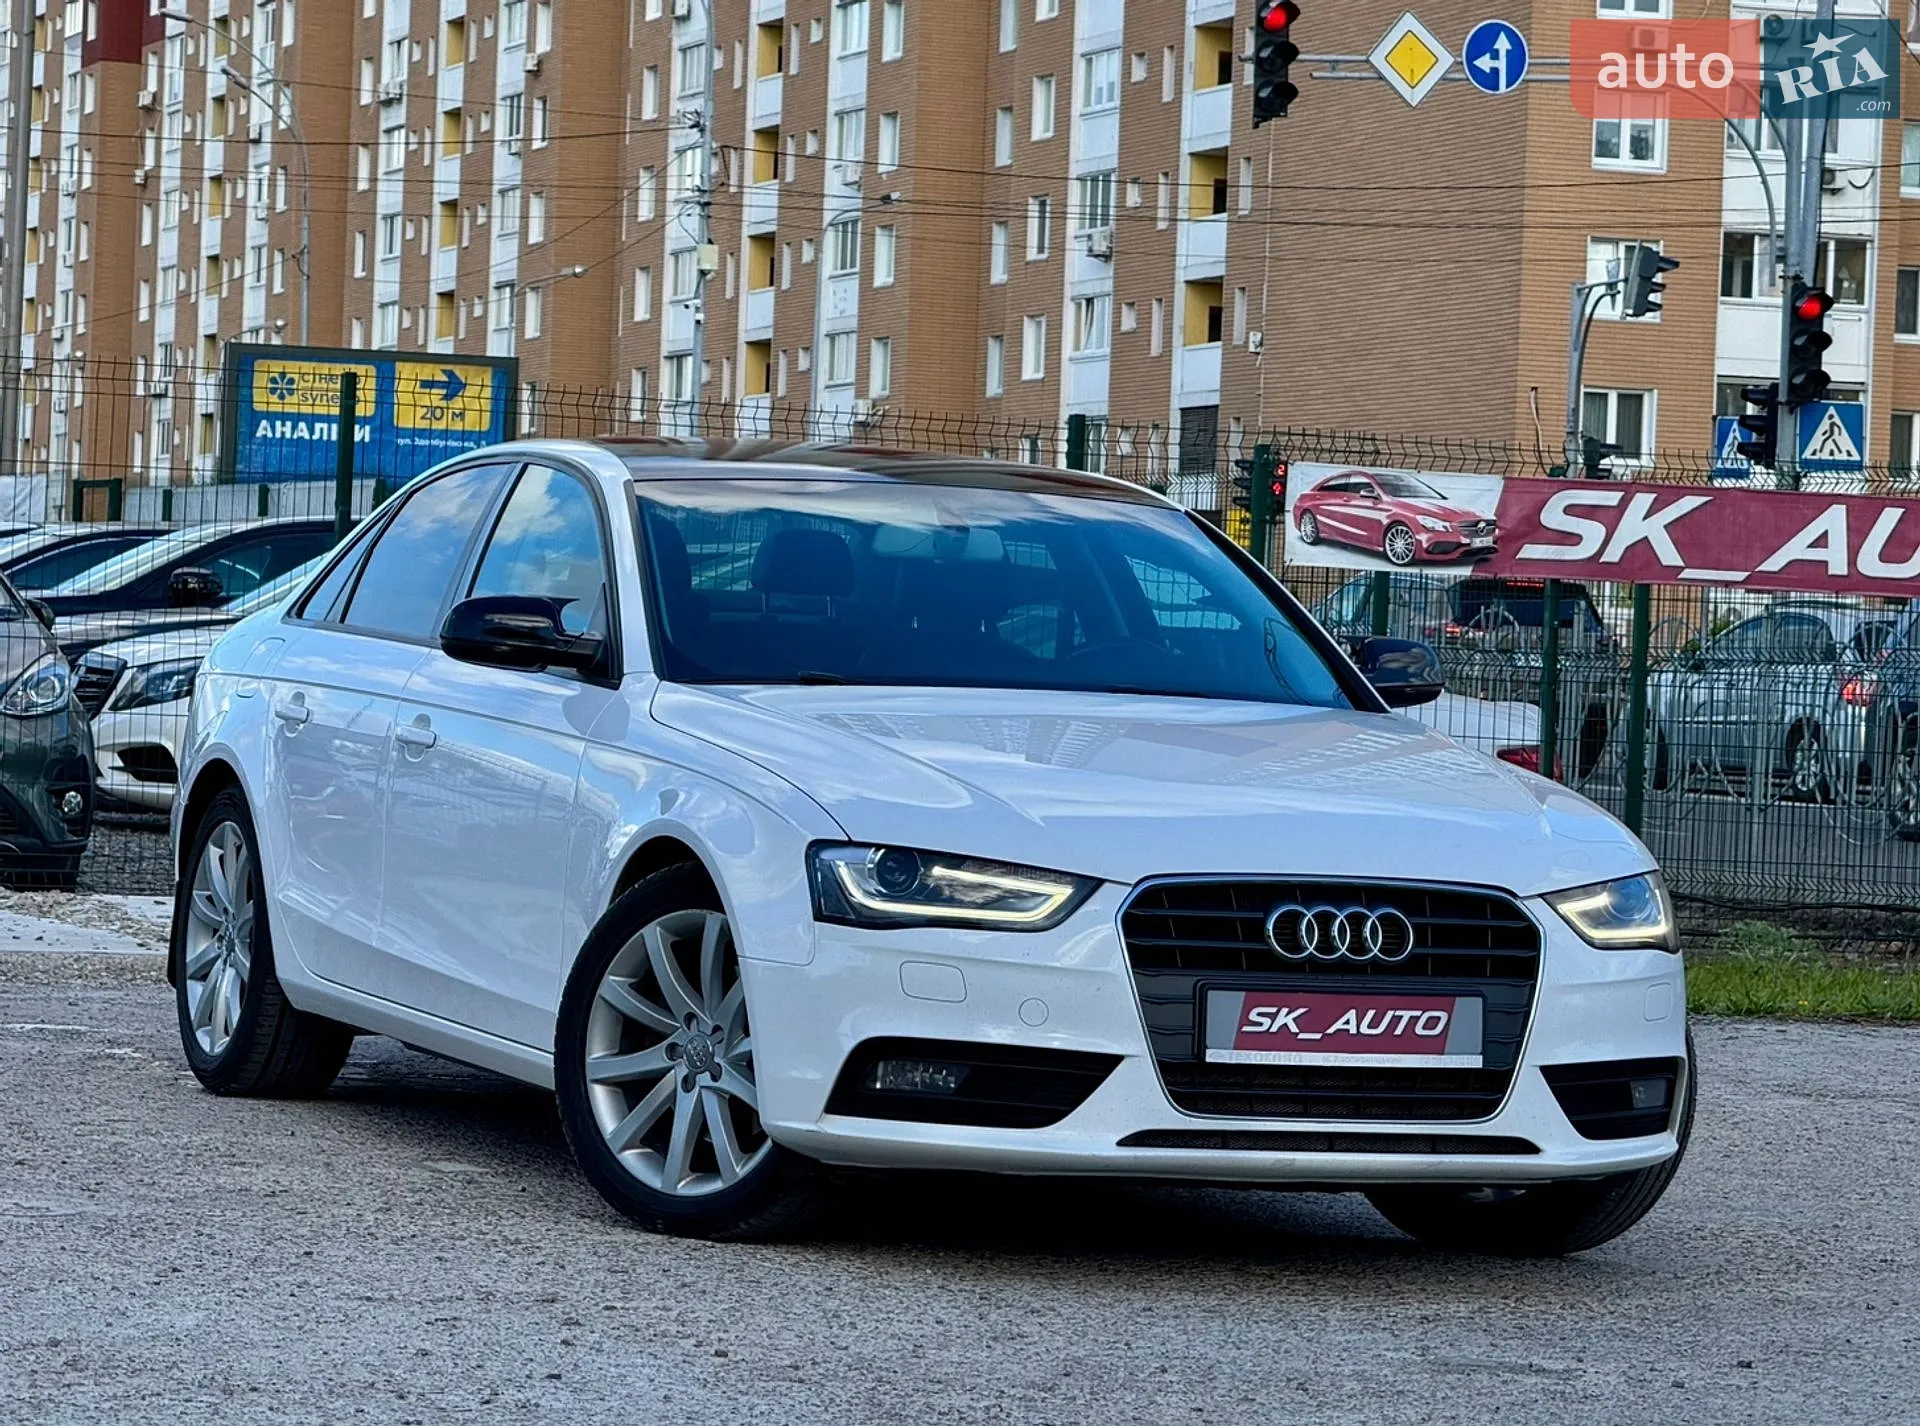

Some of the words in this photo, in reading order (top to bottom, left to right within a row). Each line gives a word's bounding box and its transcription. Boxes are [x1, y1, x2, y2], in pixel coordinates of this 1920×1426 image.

[420, 406, 445, 421] 20
[255, 420, 371, 443] АНАЛІИ
[1240, 1006, 1450, 1040] SK_AUTO
